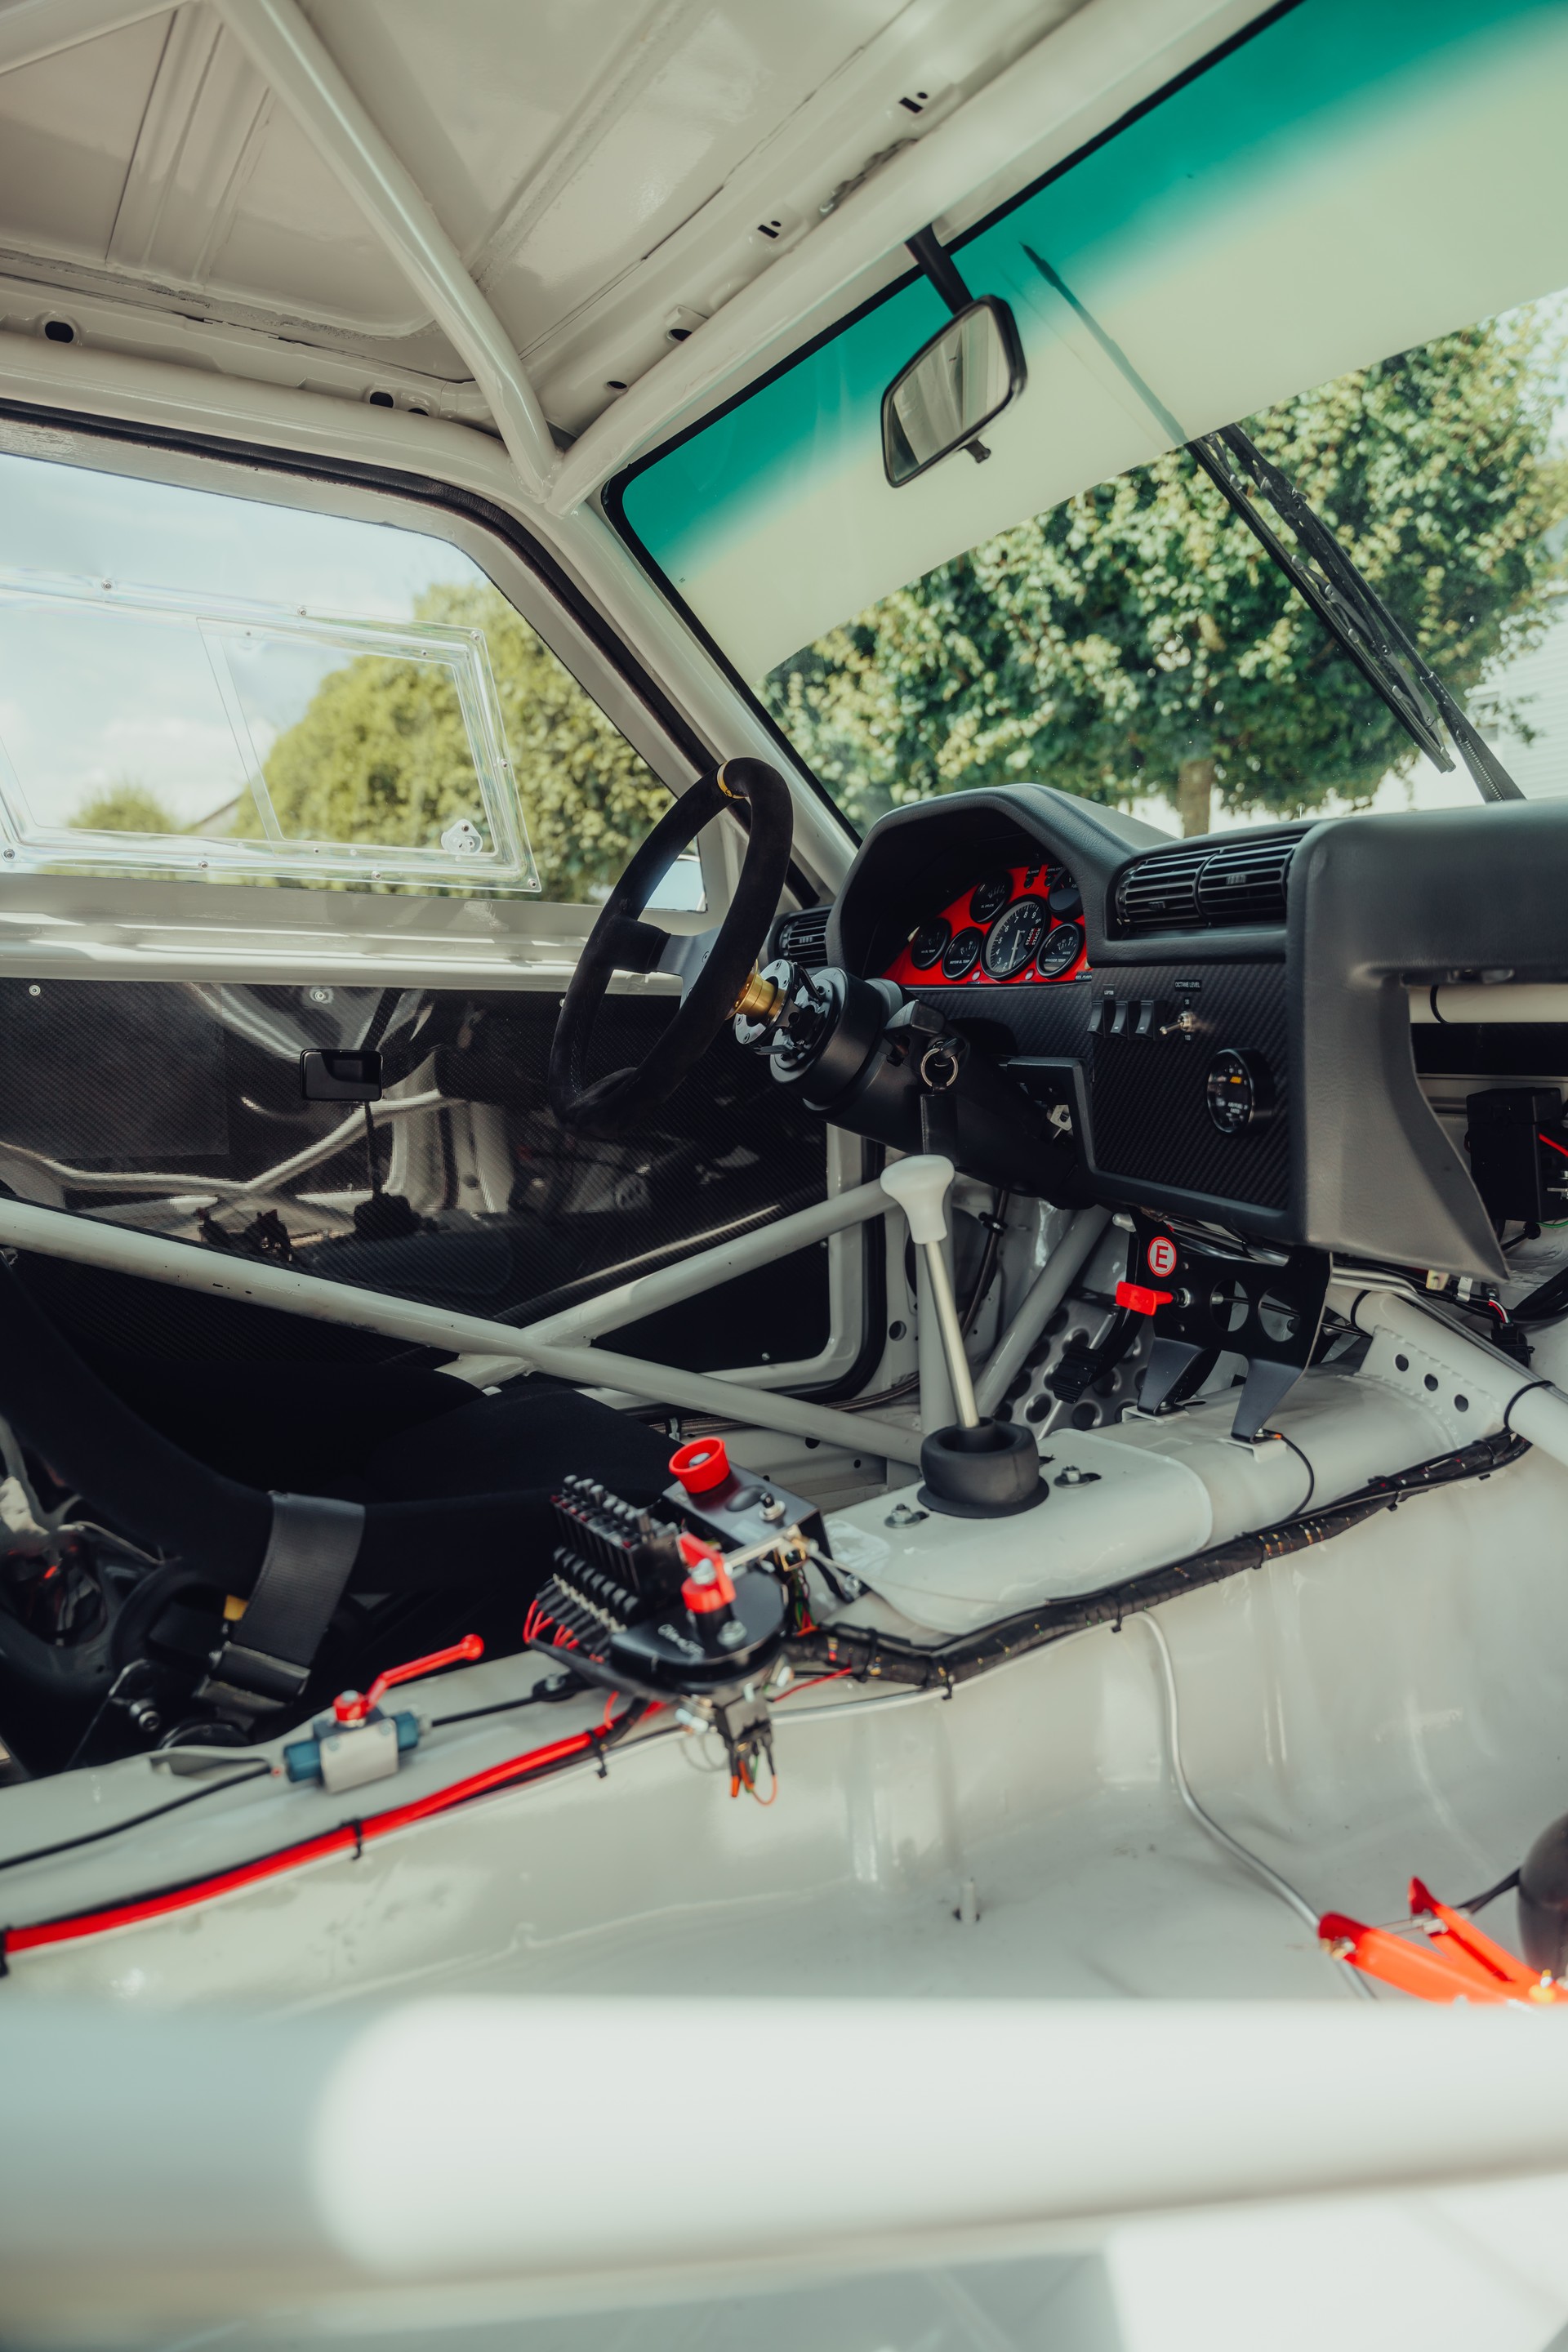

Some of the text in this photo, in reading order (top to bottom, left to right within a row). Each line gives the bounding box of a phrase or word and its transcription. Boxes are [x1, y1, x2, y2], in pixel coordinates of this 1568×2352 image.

[1026, 928, 1035, 946] STACK
[1031, 928, 1041, 946] STACK
[1156, 1245, 1169, 1269] E
